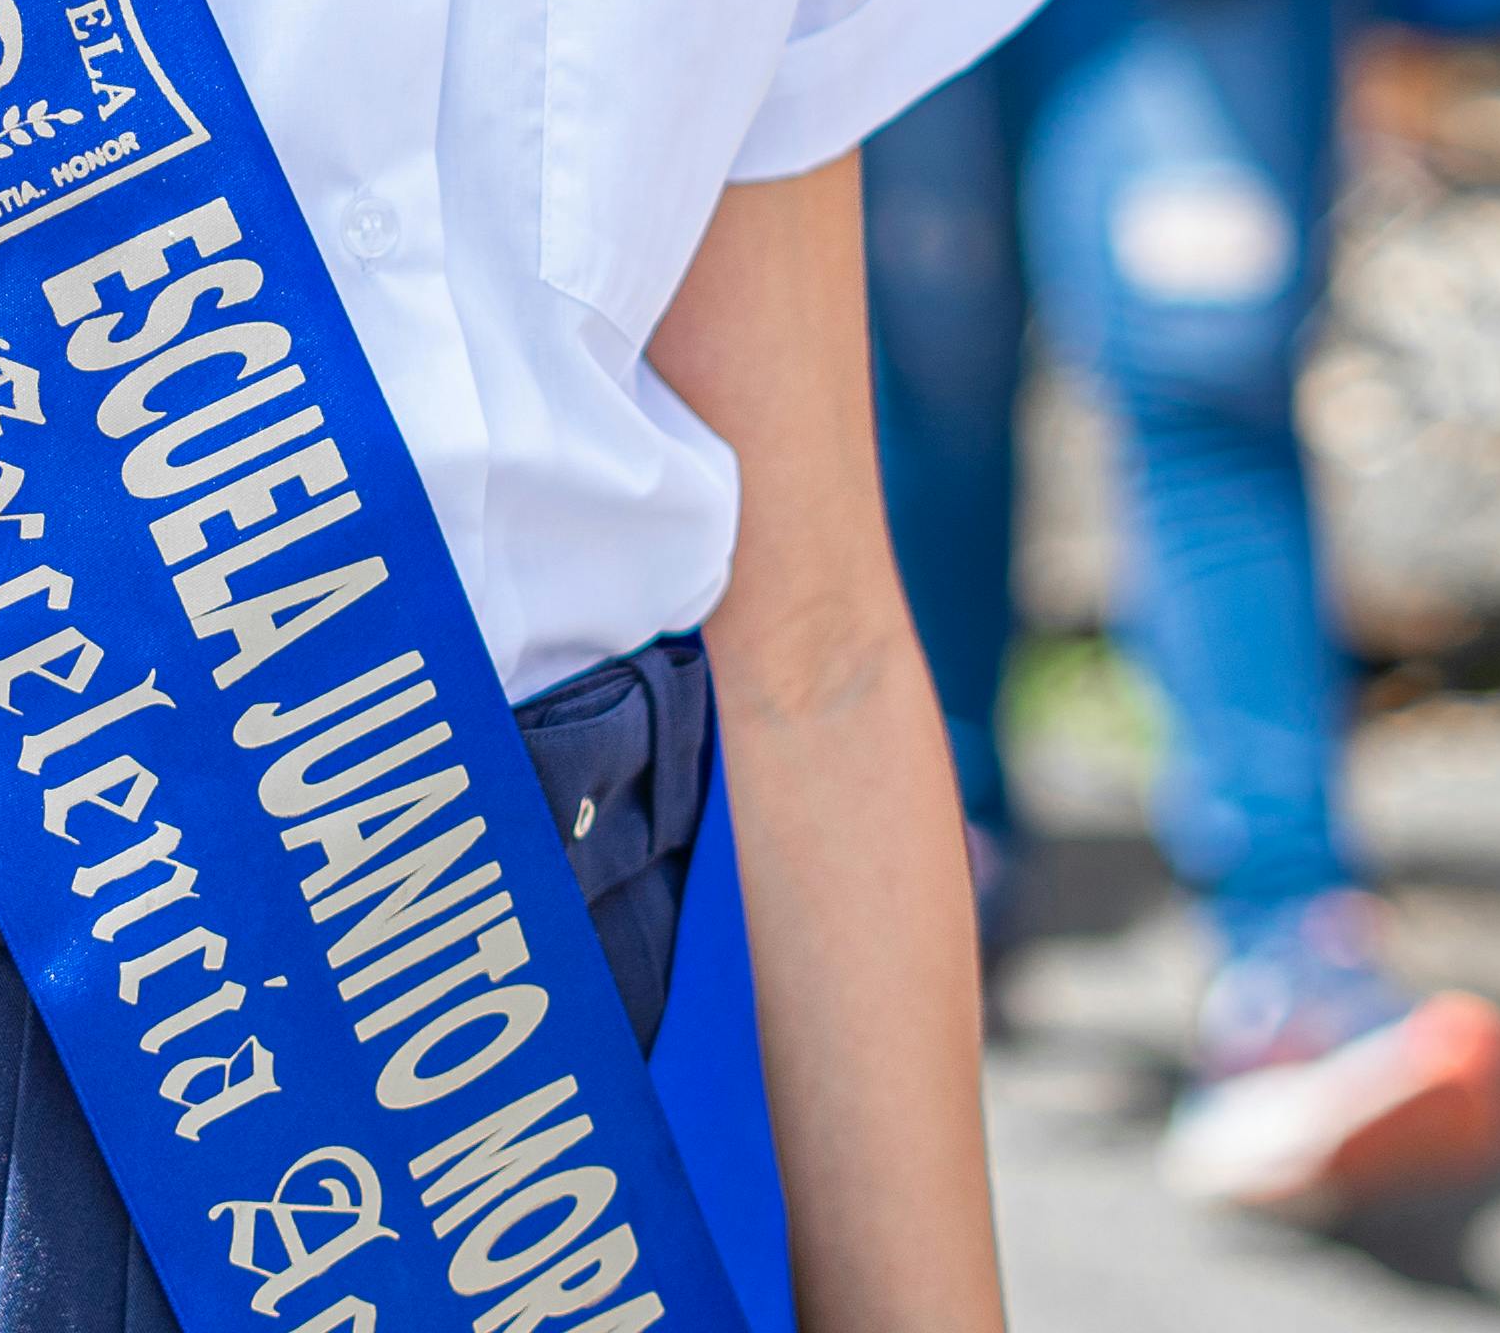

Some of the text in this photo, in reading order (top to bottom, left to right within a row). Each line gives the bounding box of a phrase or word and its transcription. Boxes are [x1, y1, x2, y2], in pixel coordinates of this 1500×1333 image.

[51, 131, 140, 187] HONOR
[41, 196, 390, 691] ESCUELA
[232, 649, 549, 1110] JUANITO
